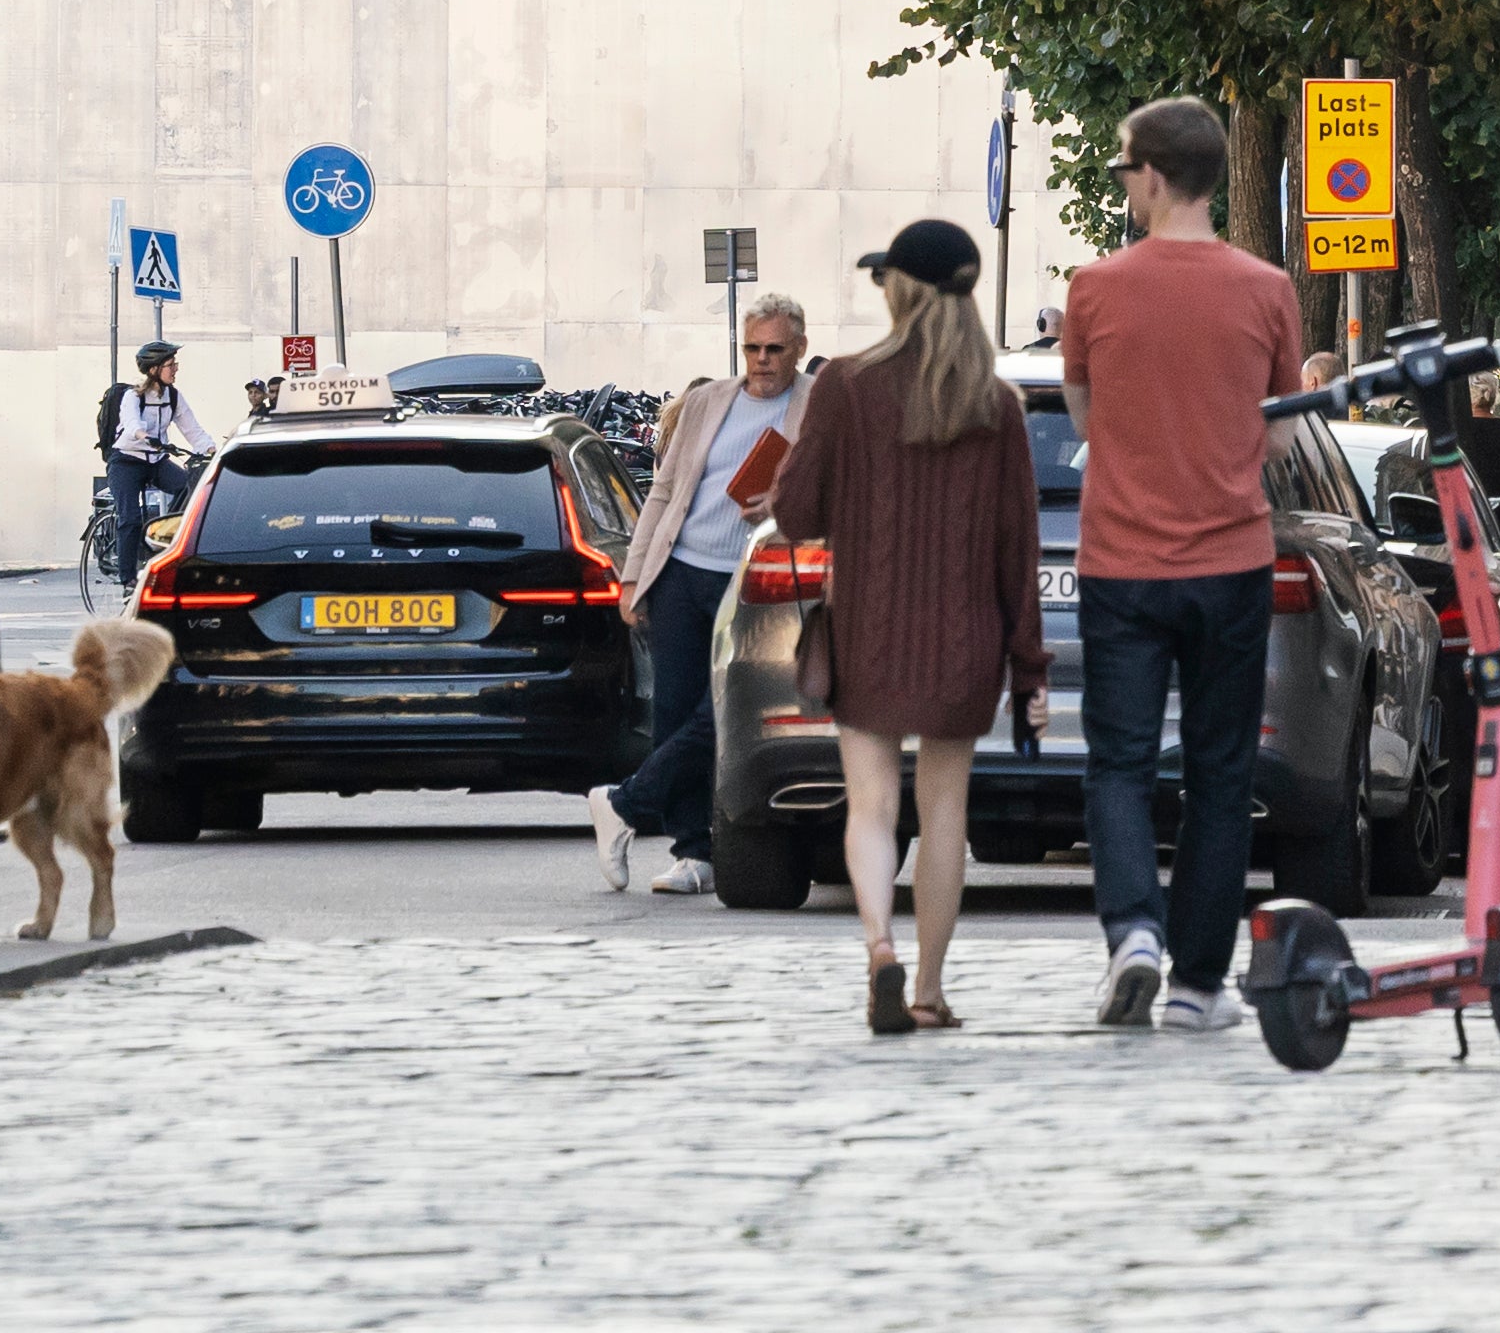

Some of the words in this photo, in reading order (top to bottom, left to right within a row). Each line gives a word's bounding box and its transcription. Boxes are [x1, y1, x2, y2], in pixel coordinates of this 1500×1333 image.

[1318, 93, 1381, 112] Last-
[1319, 118, 1380, 141] plats
[1313, 234, 1367, 256] 0-12
[1371, 237, 1390, 253] m
[290, 379, 379, 392] STOCKHOLM
[318, 391, 356, 406] 507
[294, 548, 461, 560] VOLVO
[1038, 571, 1077, 597] 20
[325, 599, 379, 625] GOH
[389, 599, 444, 623] 80G
[187, 618, 221, 629] V90
